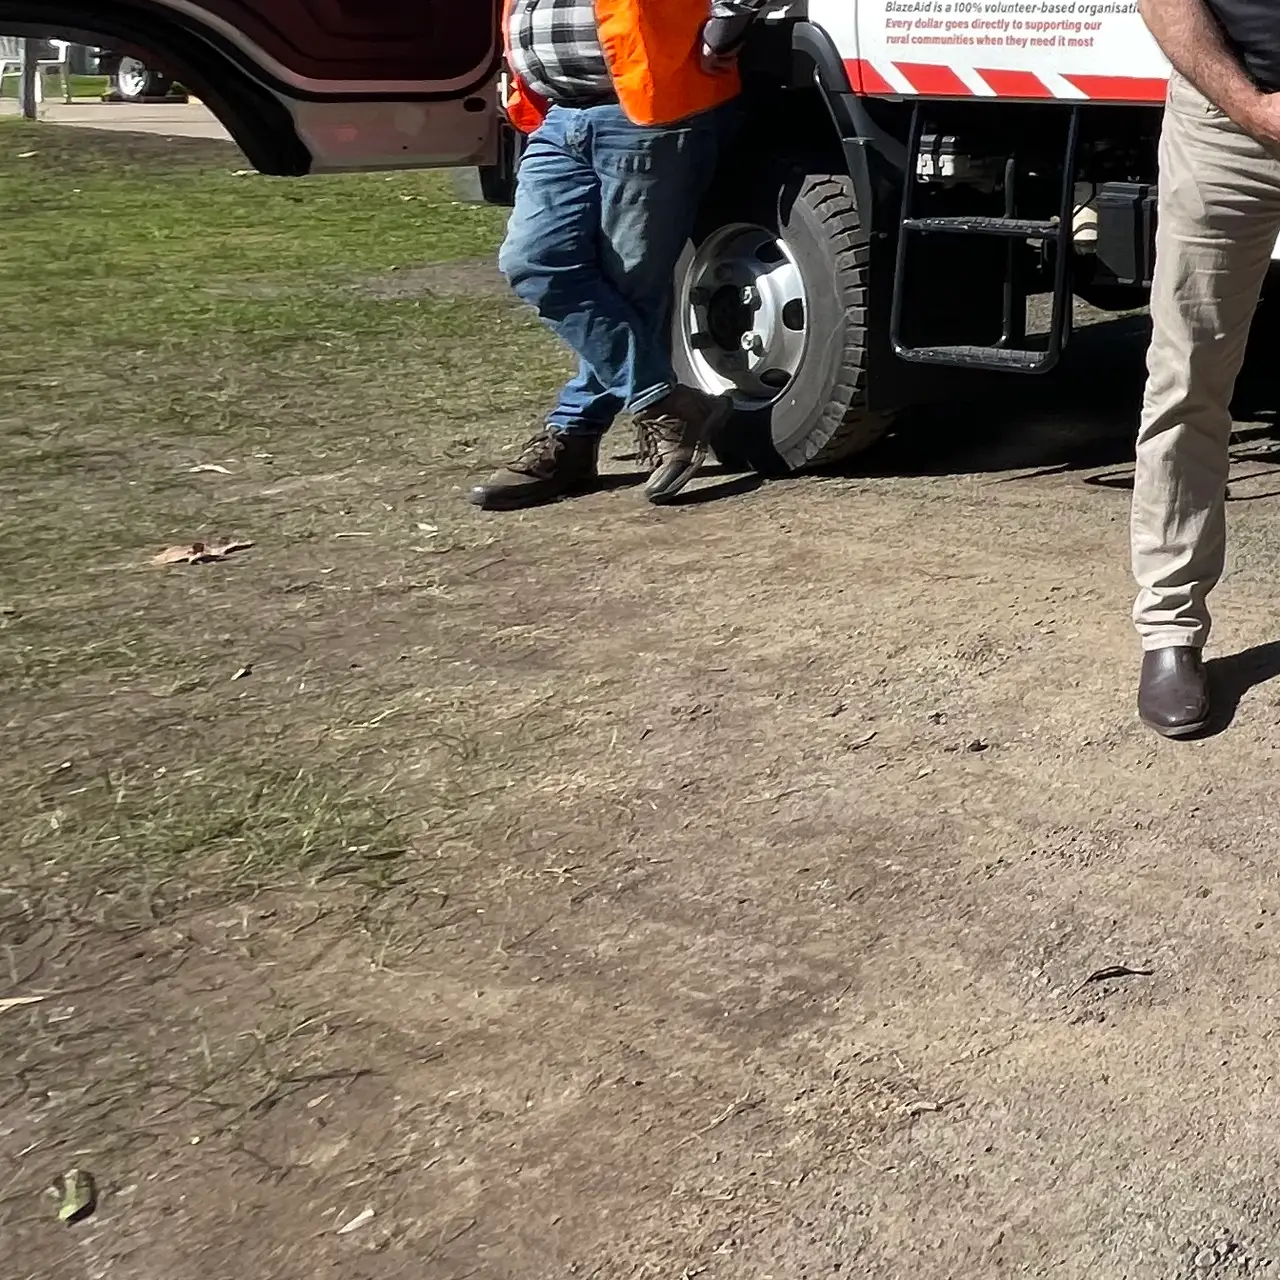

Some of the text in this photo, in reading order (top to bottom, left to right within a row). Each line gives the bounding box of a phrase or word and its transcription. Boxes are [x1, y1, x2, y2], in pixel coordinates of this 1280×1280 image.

[885, 1, 1140, 17] BlazeAid is a 100% volunteer-based organisati
[885, 18, 1103, 34] Every dollar goes directly to supporting our
[886, 34, 1095, 48] rural communities when they need it most
